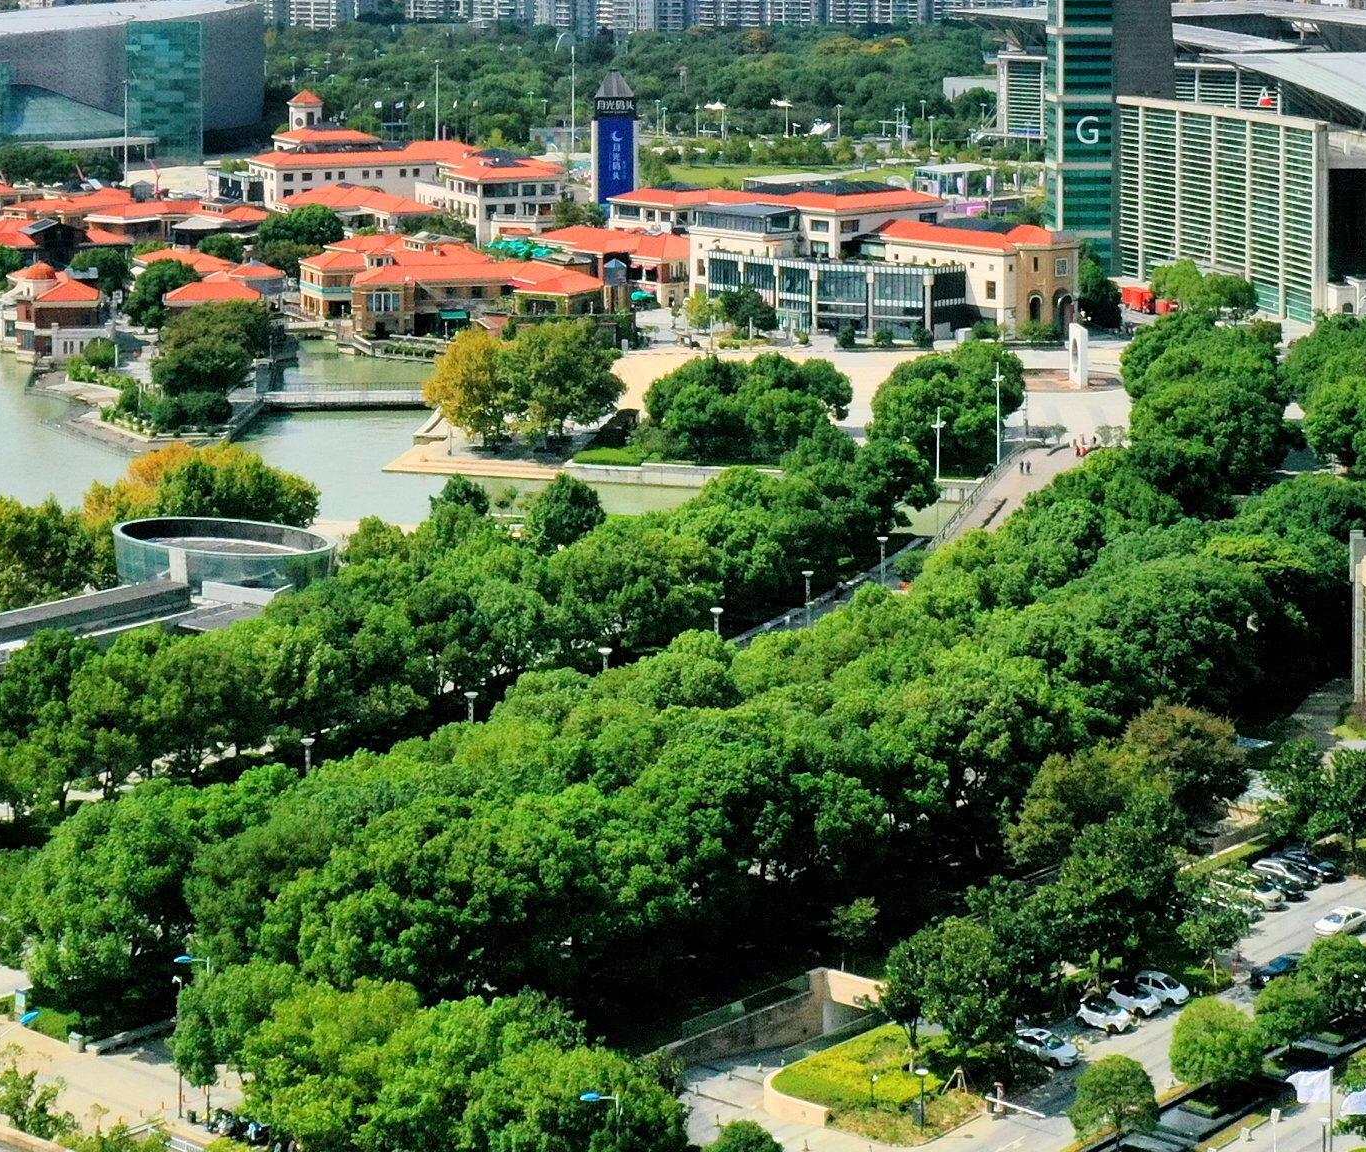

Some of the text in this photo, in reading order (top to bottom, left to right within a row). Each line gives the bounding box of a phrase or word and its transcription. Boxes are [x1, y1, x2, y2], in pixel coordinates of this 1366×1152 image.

[597, 100, 634, 110] 月光码头
[1076, 116, 1099, 144] G
